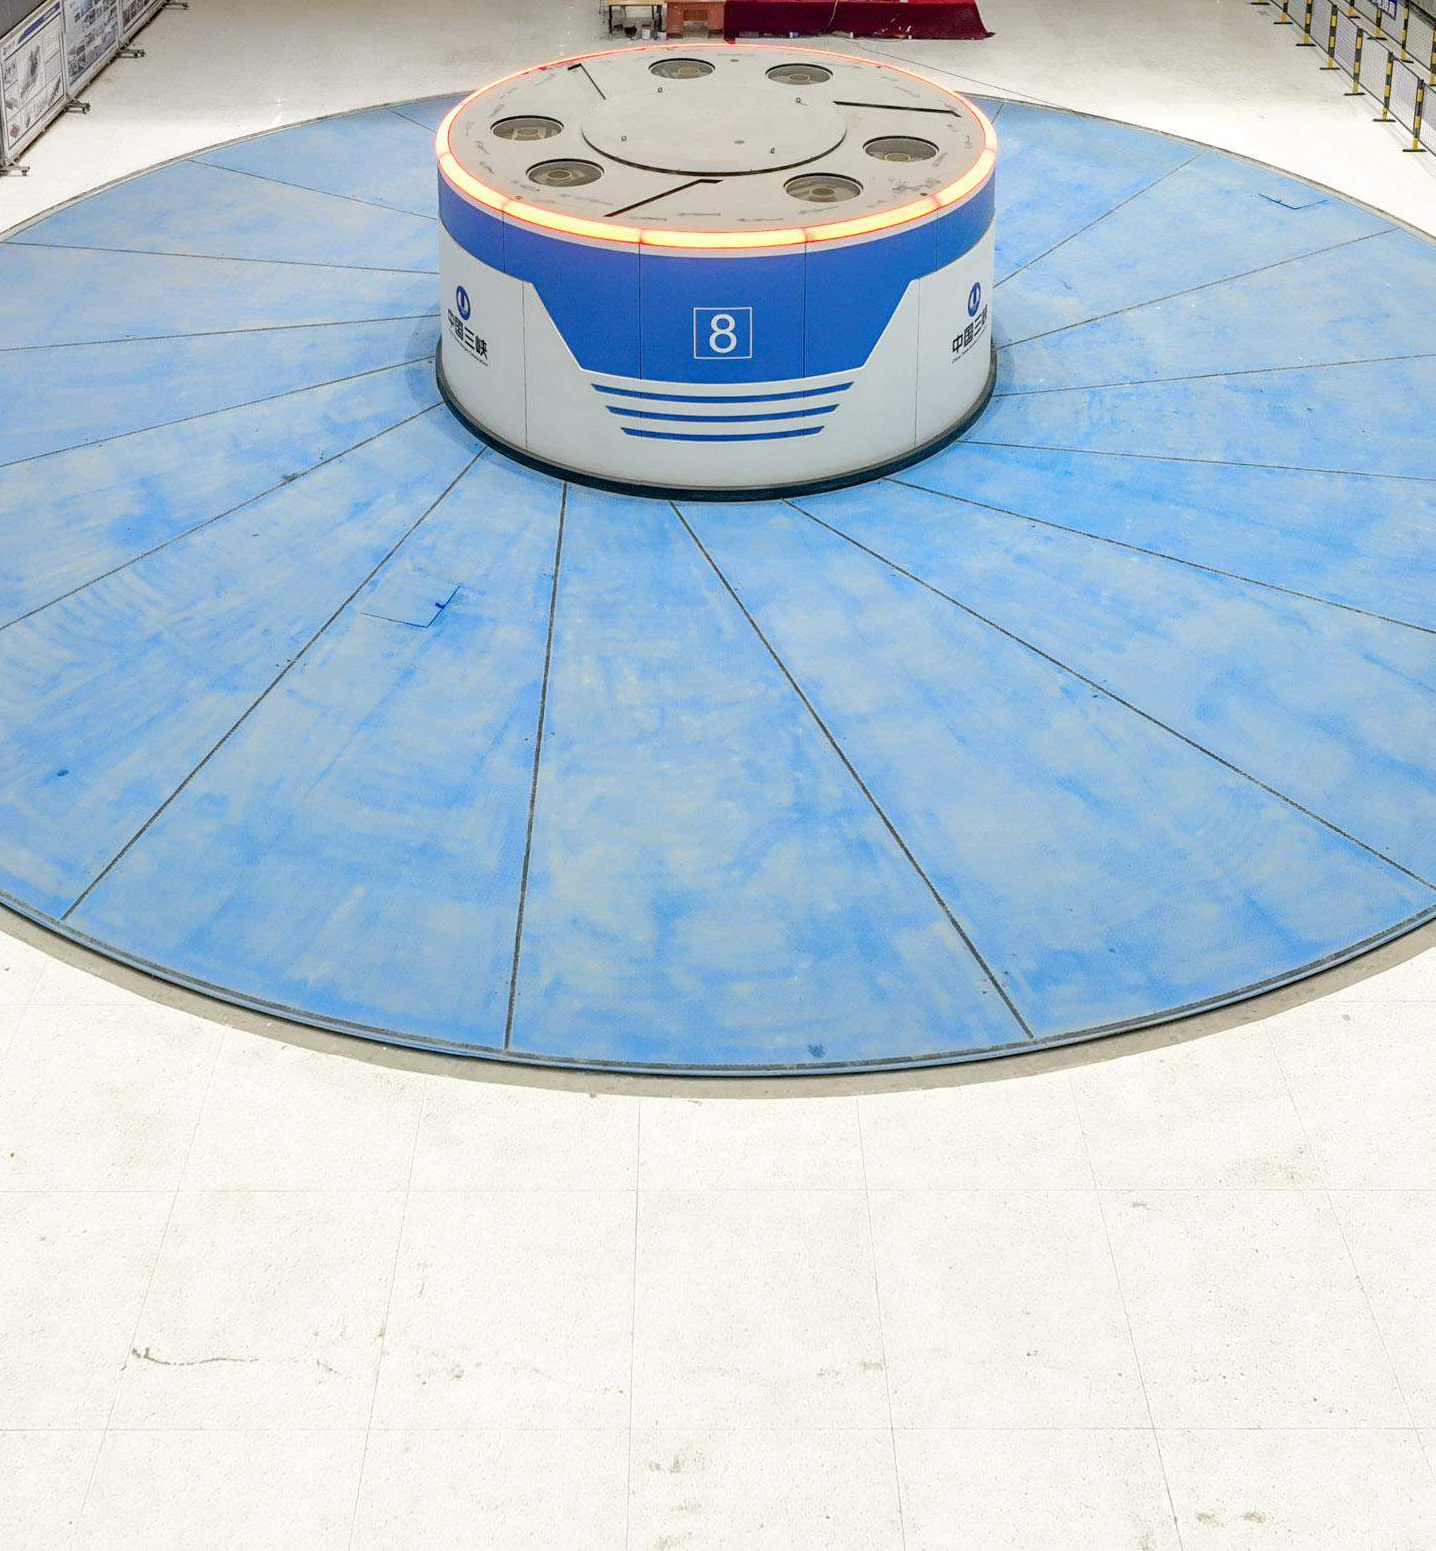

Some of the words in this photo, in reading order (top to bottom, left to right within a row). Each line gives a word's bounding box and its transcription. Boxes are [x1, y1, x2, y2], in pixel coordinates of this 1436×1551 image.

[447, 309, 488, 360] 中国三峡
[709, 314, 737, 353] 8
